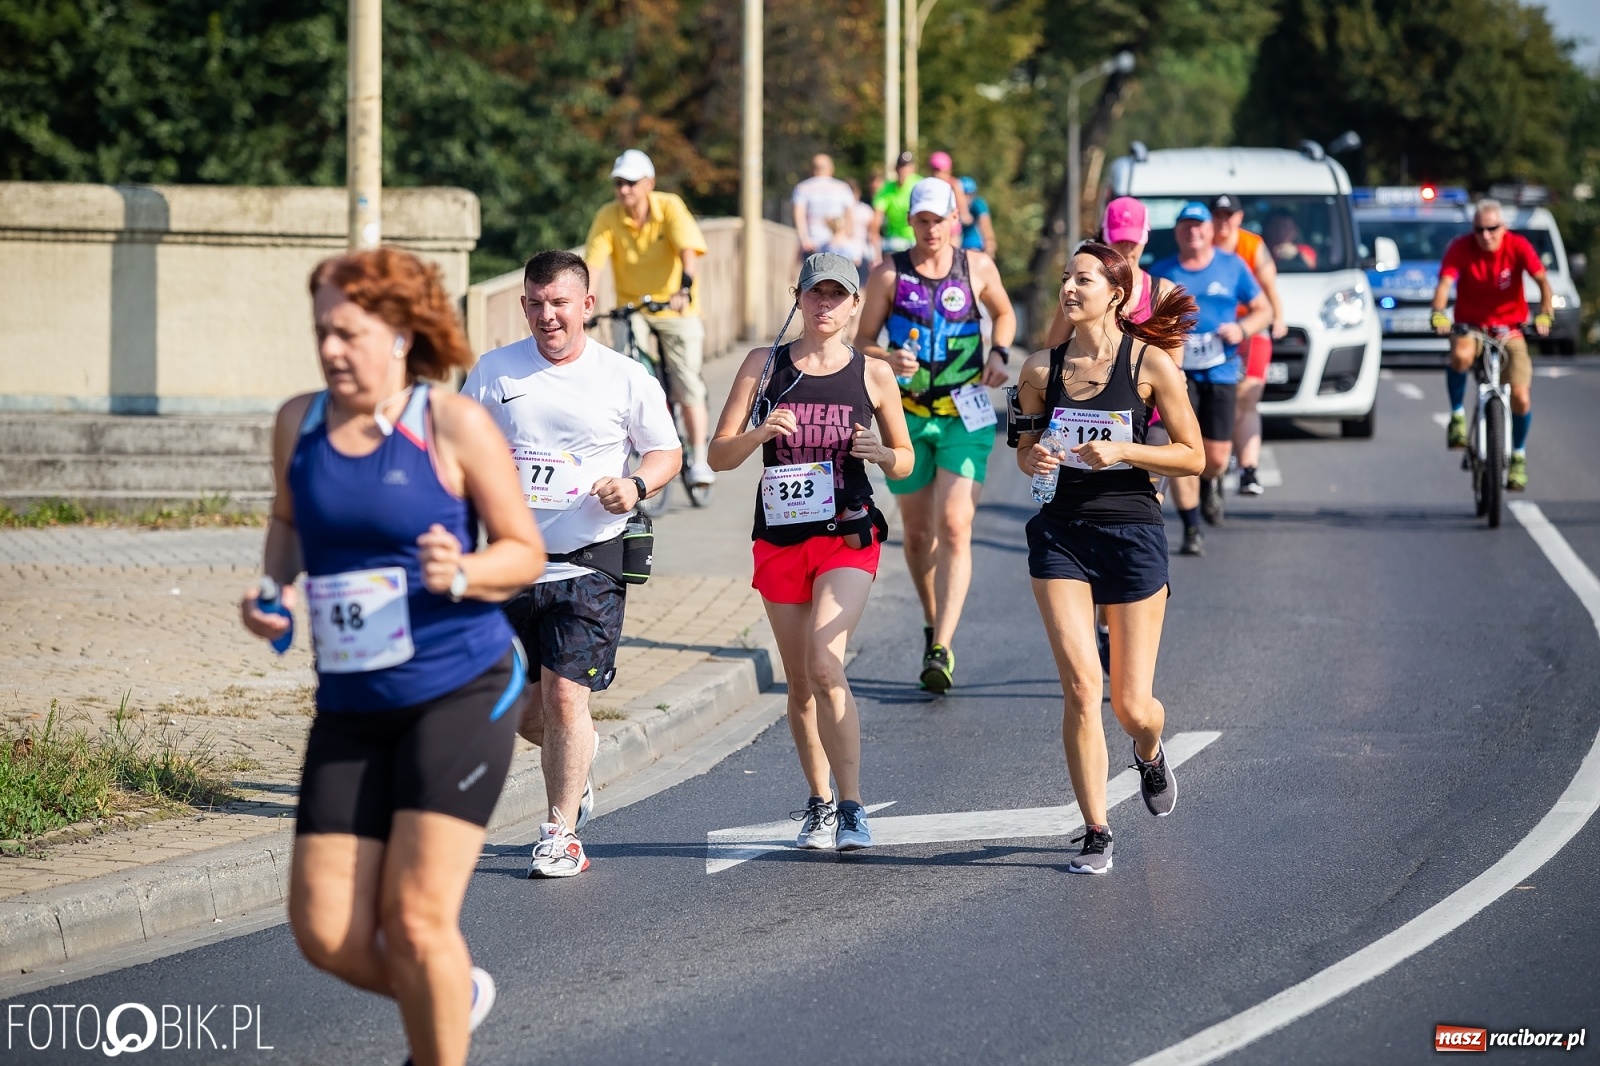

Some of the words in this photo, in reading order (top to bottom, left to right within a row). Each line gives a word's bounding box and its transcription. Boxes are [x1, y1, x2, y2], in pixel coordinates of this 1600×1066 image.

[1076, 425, 1112, 445] 128
[531, 464, 555, 485] 77
[778, 479, 815, 501] 323
[330, 602, 365, 633] 48
